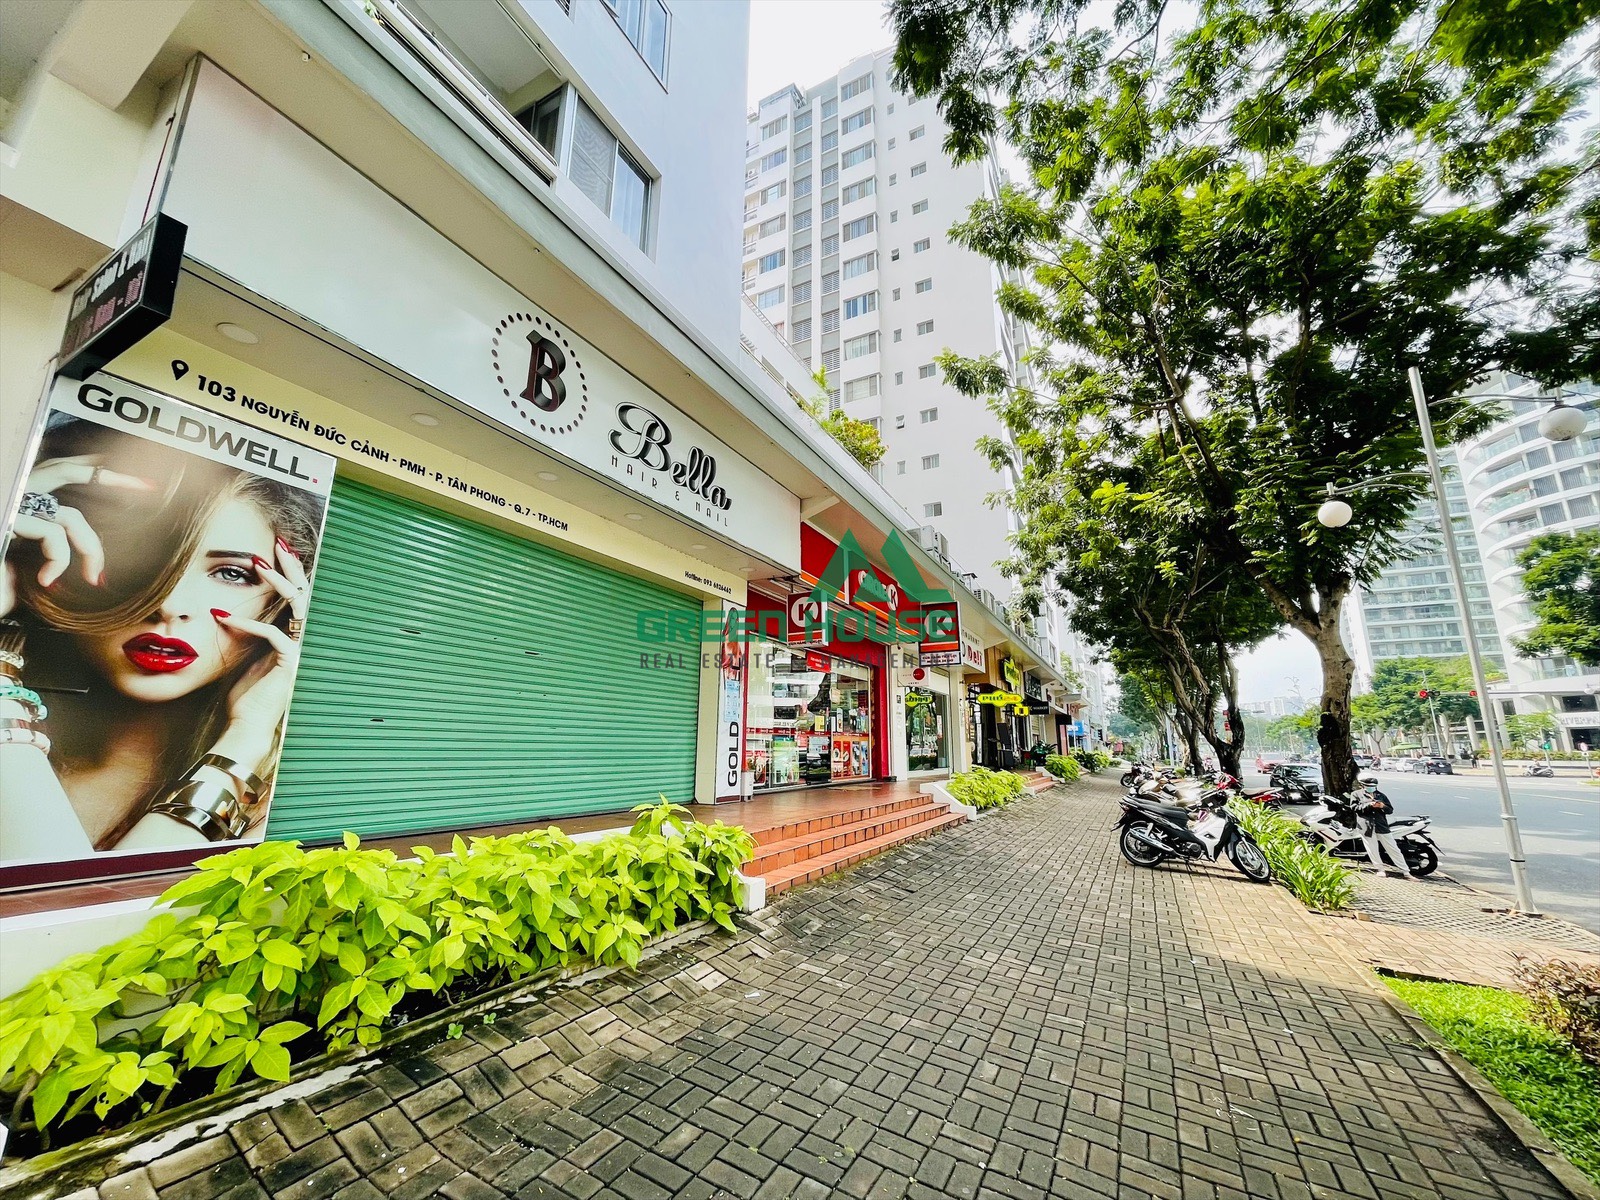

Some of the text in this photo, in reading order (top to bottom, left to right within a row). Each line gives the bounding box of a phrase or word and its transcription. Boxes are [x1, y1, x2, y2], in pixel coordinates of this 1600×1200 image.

[519, 329, 567, 412] B
[197, 374, 236, 402] 103
[241, 394, 310, 432] NGUYỄN
[314, 424, 346, 445] ĐỨC
[350, 440, 389, 463] CẢNH
[399, 458, 426, 477] PMH
[435, 472, 444, 484] P.
[447, 477, 468, 493] TÂN
[470, 486, 506, 507] PHONG
[538, 512, 568, 531] TP.HCM
[607, 401, 732, 510] Bella
[611, 454, 728, 527] HAIR & NAIL
